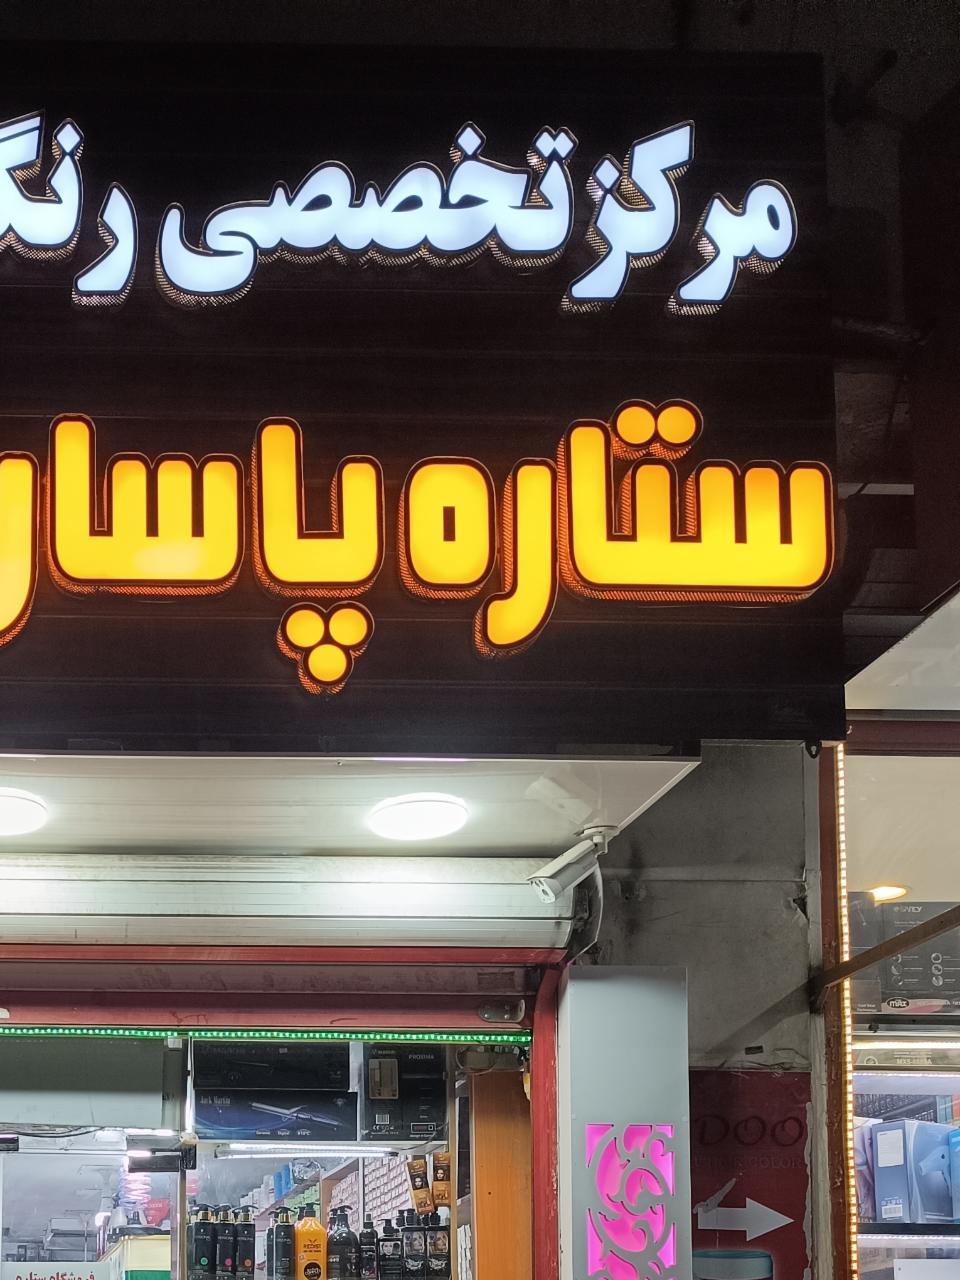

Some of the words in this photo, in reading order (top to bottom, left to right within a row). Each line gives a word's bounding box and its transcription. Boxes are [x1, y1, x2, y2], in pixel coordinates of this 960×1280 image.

[156, 121, 574, 295] تخصصی
[569, 120, 797, 302] مرکز
[402, 398, 834, 651] ستاره
